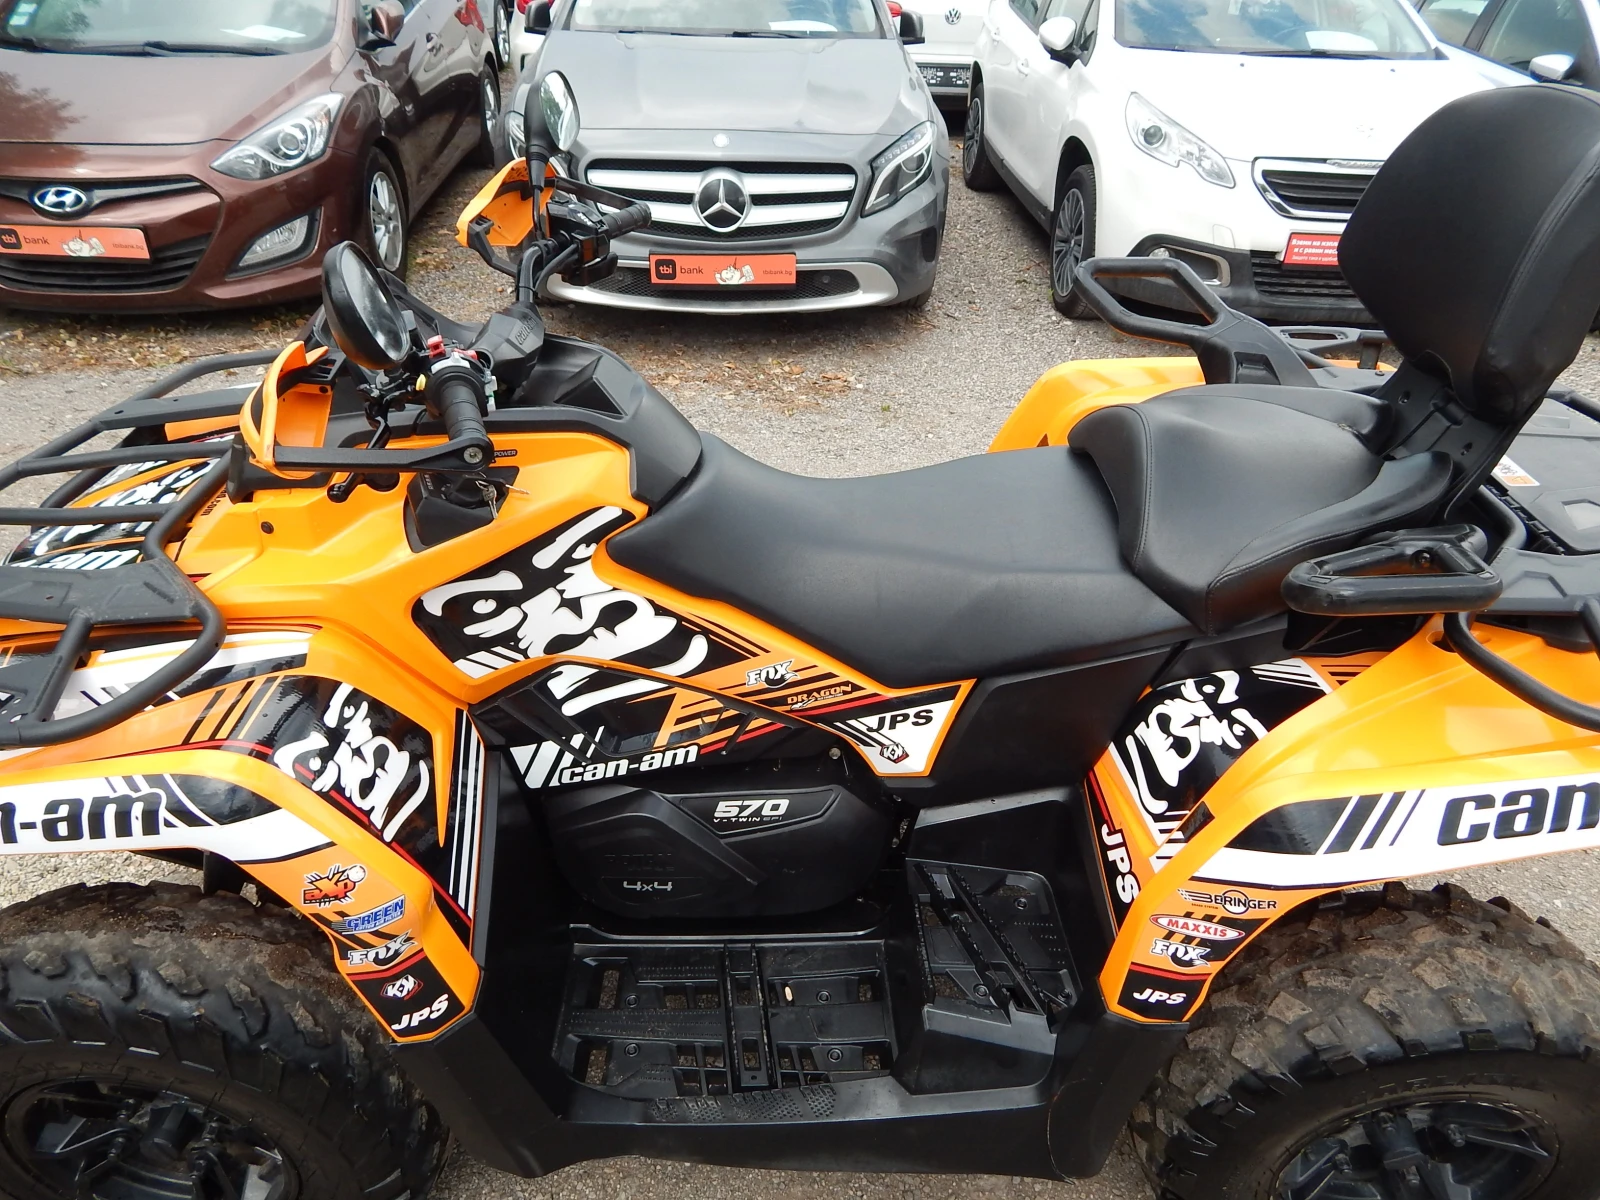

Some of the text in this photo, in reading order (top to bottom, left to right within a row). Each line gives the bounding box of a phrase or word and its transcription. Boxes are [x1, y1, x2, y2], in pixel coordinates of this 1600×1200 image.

[23, 236, 50, 245] bank
[659, 265, 673, 274] tbi
[680, 266, 704, 275] bank
[746, 659, 798, 688] FOX
[787, 684, 852, 704] DRAGON
[866, 709, 934, 733] JPS
[561, 745, 699, 784] can-am
[714, 799, 790, 818] 570
[1437, 782, 1600, 846] can
[1101, 823, 1140, 904] JPS
[623, 881, 673, 891] 4x4
[1178, 889, 1277, 914] BERINGER
[347, 898, 404, 930] GREEN
[1167, 919, 1228, 938] MAXXIS
[349, 930, 417, 967] FOX
[1151, 938, 1212, 968] FOX
[1132, 988, 1187, 1005] JPS
[391, 993, 449, 1030] JPS
